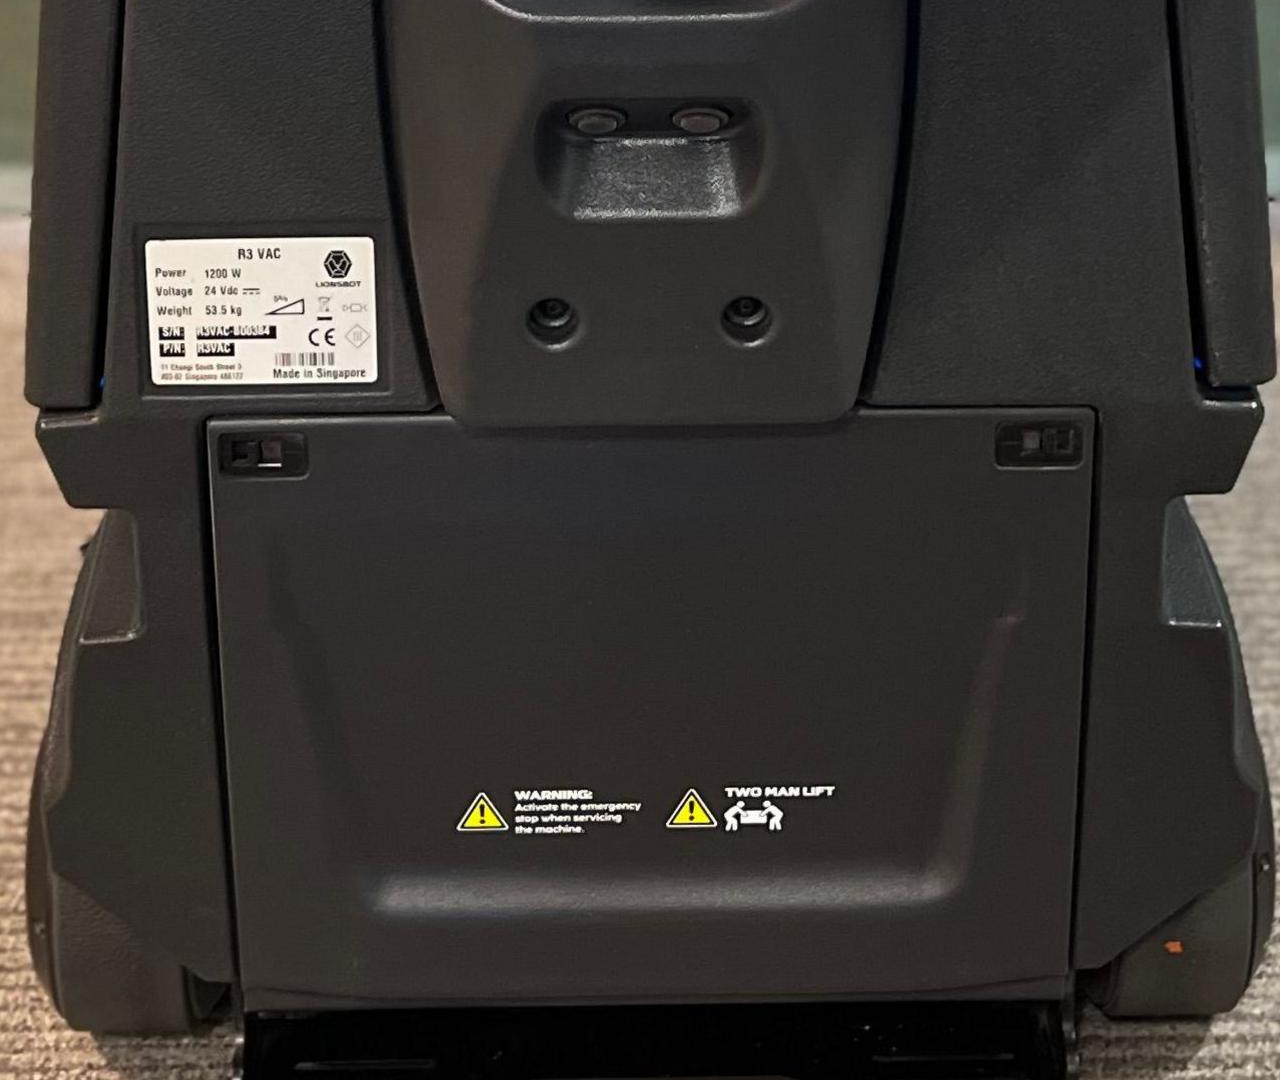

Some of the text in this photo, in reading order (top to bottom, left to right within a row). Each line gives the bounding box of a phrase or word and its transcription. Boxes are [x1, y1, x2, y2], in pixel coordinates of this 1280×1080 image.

[238, 248, 281, 260] R3 VAC
[155, 268, 241, 278] Power 1200 W
[156, 286, 238, 297] Voltage 24 Vdc
[157, 305, 242, 316] Weight 53.5 kg
[308, 328, 336, 346] CE
[273, 368, 366, 379] Made in Singapore
[514, 790, 593, 800] WARNING:
[725, 786, 835, 797] TWO MAN LIFT
[515, 803, 641, 812] Activate the emergency
[515, 813, 622, 823] stop when servicing
[515, 826, 533, 834] the
